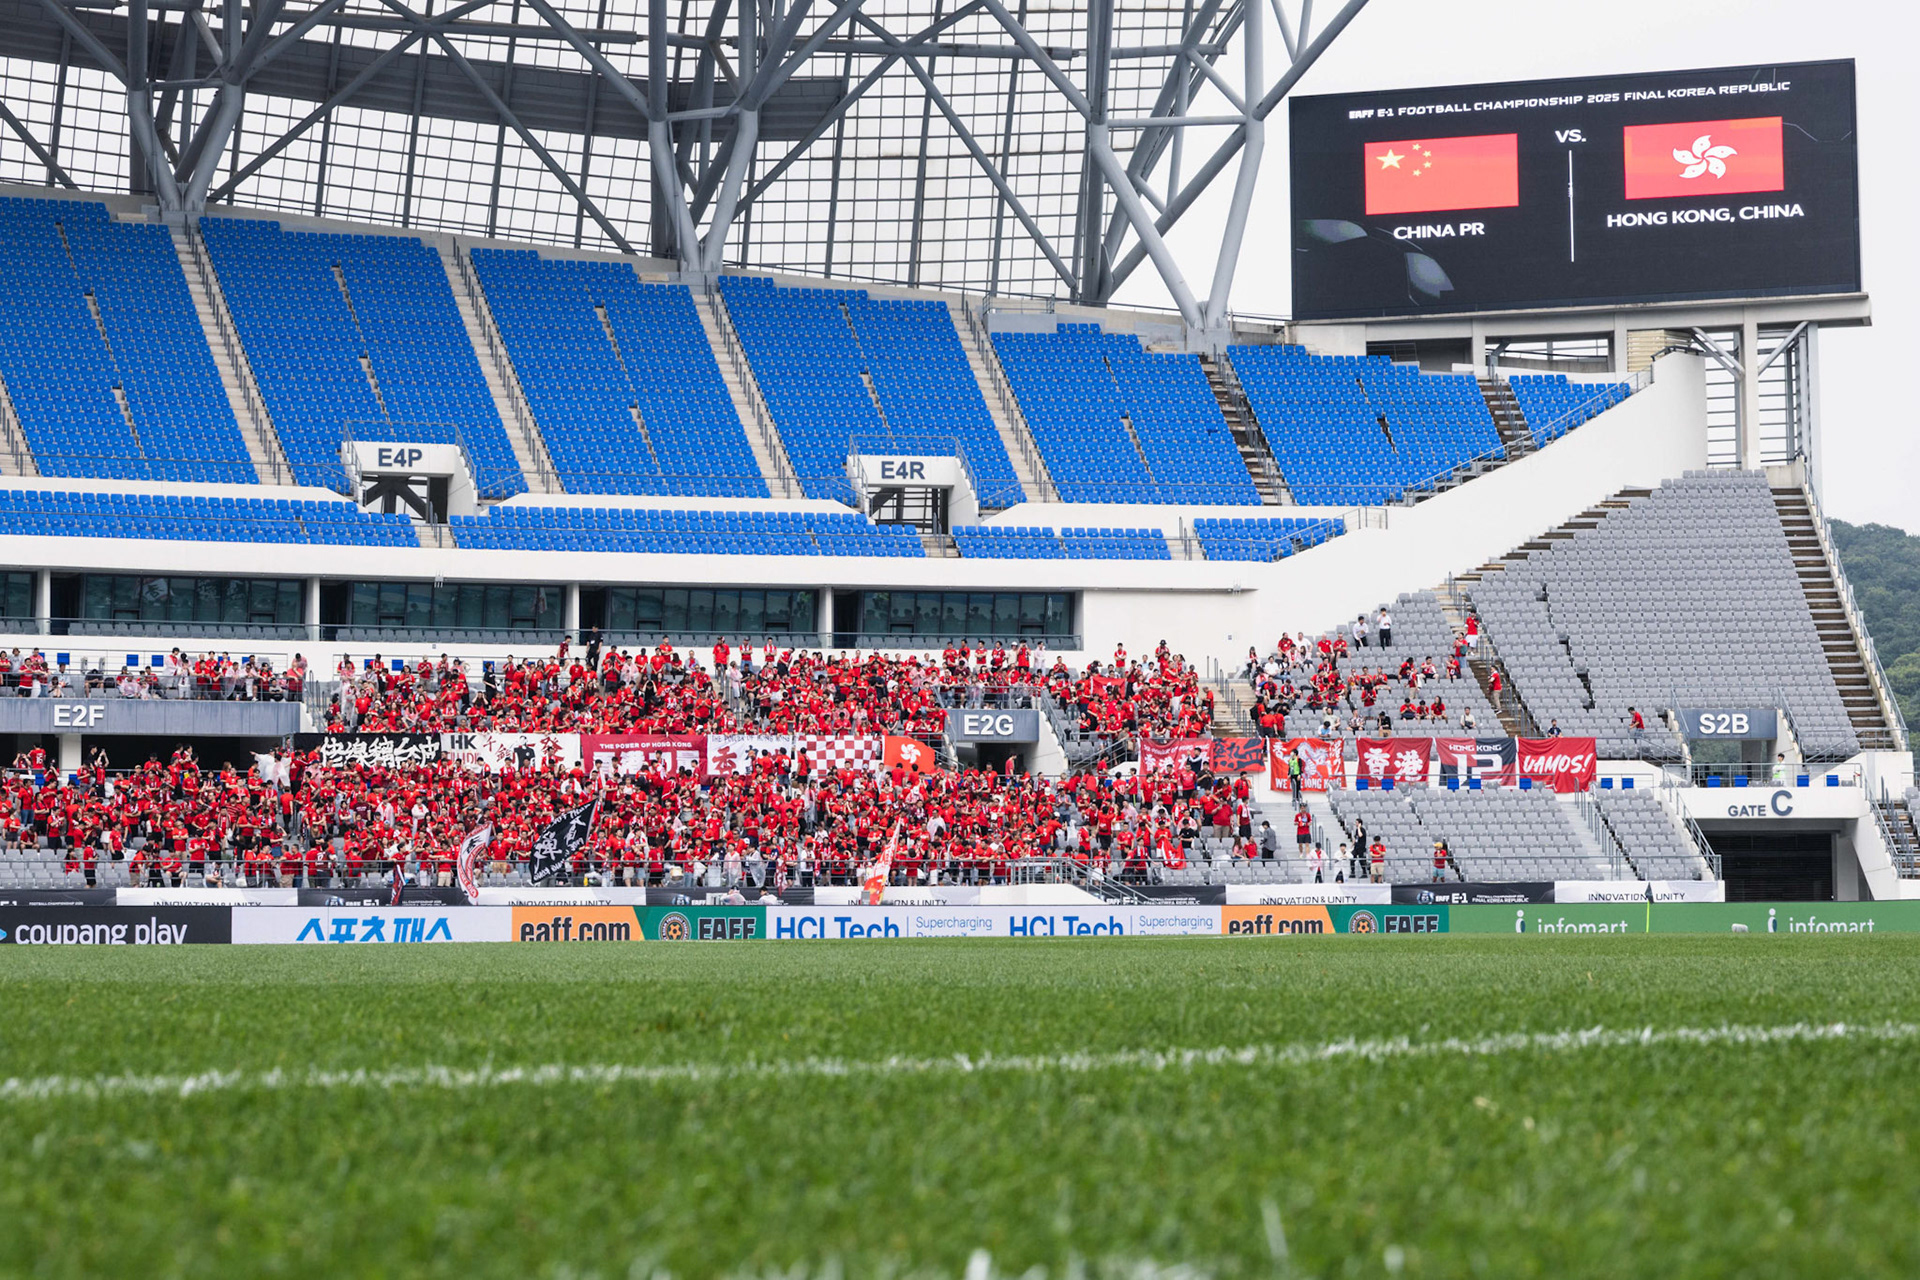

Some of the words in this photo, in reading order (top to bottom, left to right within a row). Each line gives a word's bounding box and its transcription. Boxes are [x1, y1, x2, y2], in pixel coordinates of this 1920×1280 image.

[1348, 109, 1374, 119] EAFF
[1377, 108, 1394, 118] E-1
[1398, 103, 1471, 116] FOOTBALL
[1474, 96, 1583, 111] CHAMPIONSHIP
[1587, 93, 1620, 104] 2025
[1624, 90, 1666, 101] FINAL
[1668, 87, 1717, 99] KOREA
[1719, 82, 1791, 95] REPUBLIC
[1555, 129, 1587, 143] VS.
[1606, 212, 1668, 228] HONG
[1671, 208, 1735, 224] KONG,
[1739, 204, 1804, 220] CHINA
[1393, 223, 1455, 240] CHINA
[1459, 222, 1485, 236] PR
[378, 448, 422, 468] E4P
[881, 460, 926, 480] E4R
[53, 704, 105, 728] E2F
[963, 713, 1015, 736] E2G
[1699, 713, 1750, 734] S2B
[450, 735, 477, 750] HK
[1364, 748, 1424, 781] 香港
[1275, 778, 1288, 789] WE
[1727, 805, 1767, 817] GATE
[1770, 789, 1794, 817] C
[1656, 892, 1686, 901] UNITY
[15, 924, 128, 944] coupang
[135, 916, 188, 944] play
[520, 916, 630, 941] eaff.com
[697, 917, 757, 940] EAFF
[916, 916, 993, 931] Supercharging
[1139, 913, 1213, 930] Supercharging
[1384, 914, 1439, 933] EAFF
[1538, 917, 1629, 933] infomart
[1788, 916, 1876, 932] infomart
